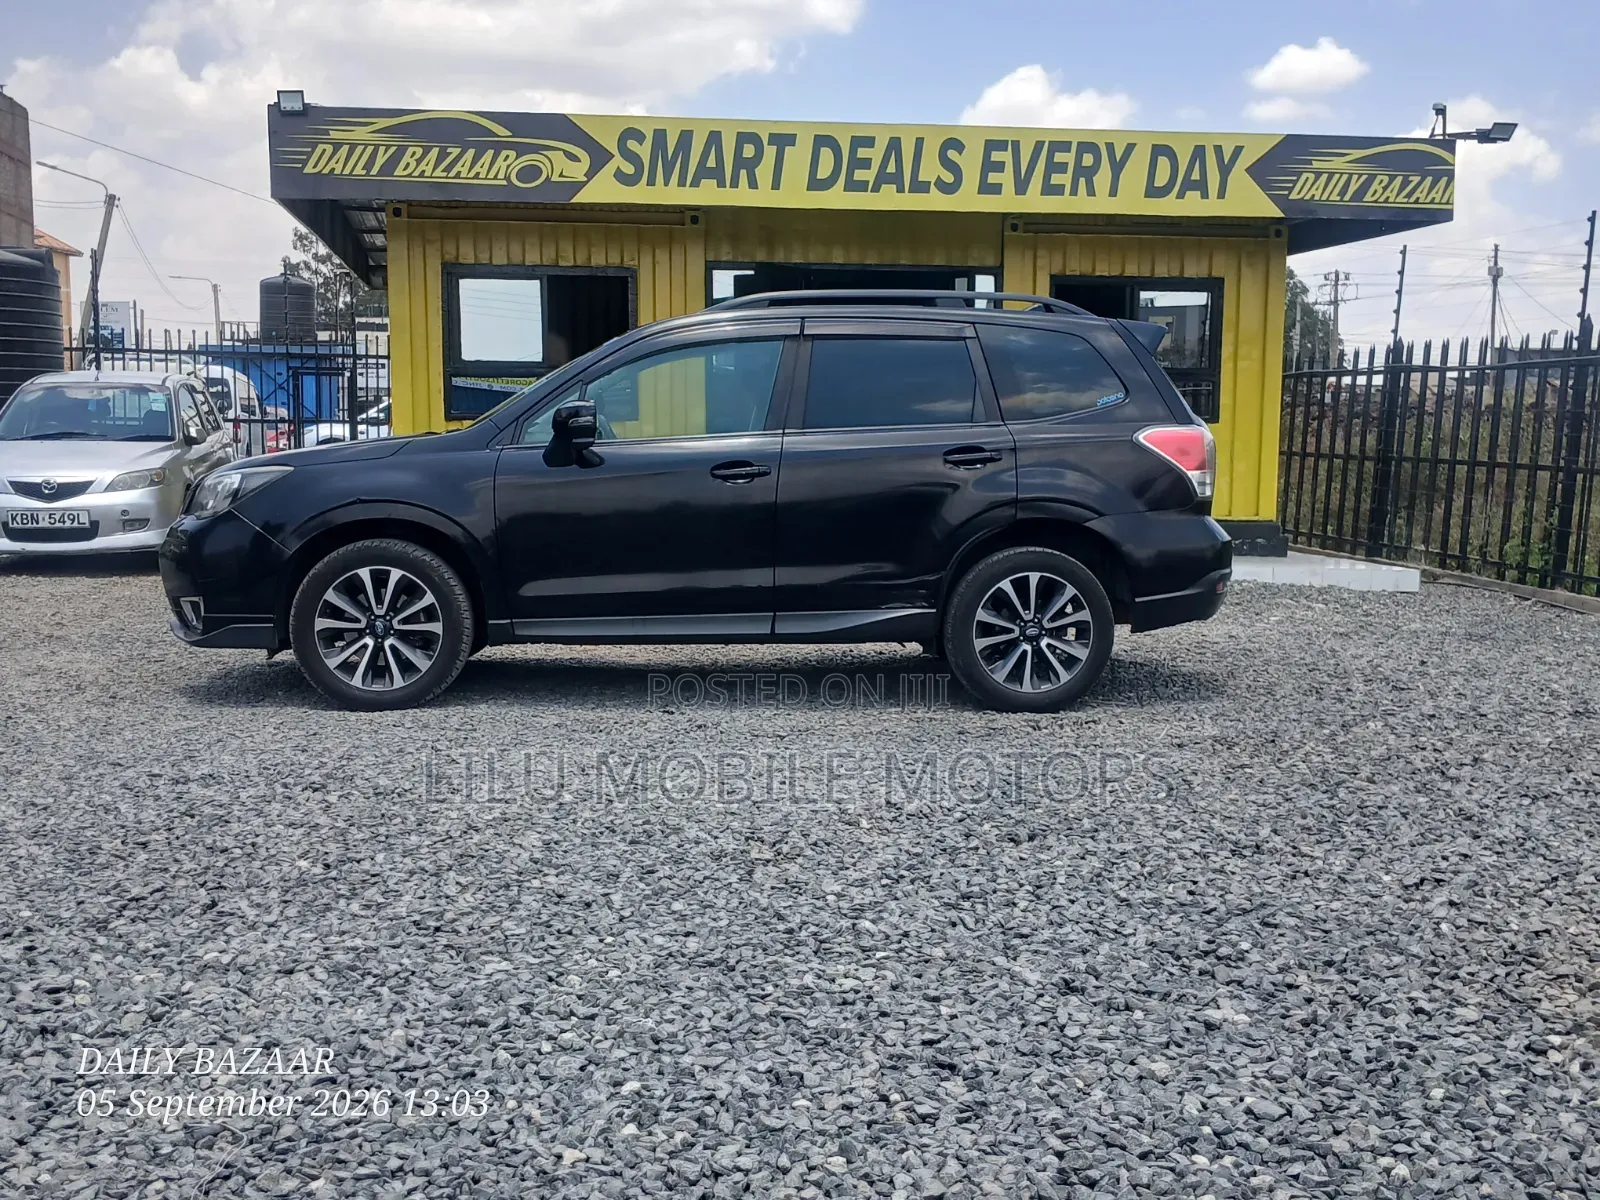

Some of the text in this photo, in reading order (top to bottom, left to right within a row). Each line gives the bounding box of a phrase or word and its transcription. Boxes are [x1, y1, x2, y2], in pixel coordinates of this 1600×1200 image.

[303, 142, 519, 180] DAILY BAZAAR
[612, 126, 1246, 201] SMART DEALS EVERY DAY
[1288, 171, 1368, 202] DAILY
[10, 512, 87, 526] KBN 549L
